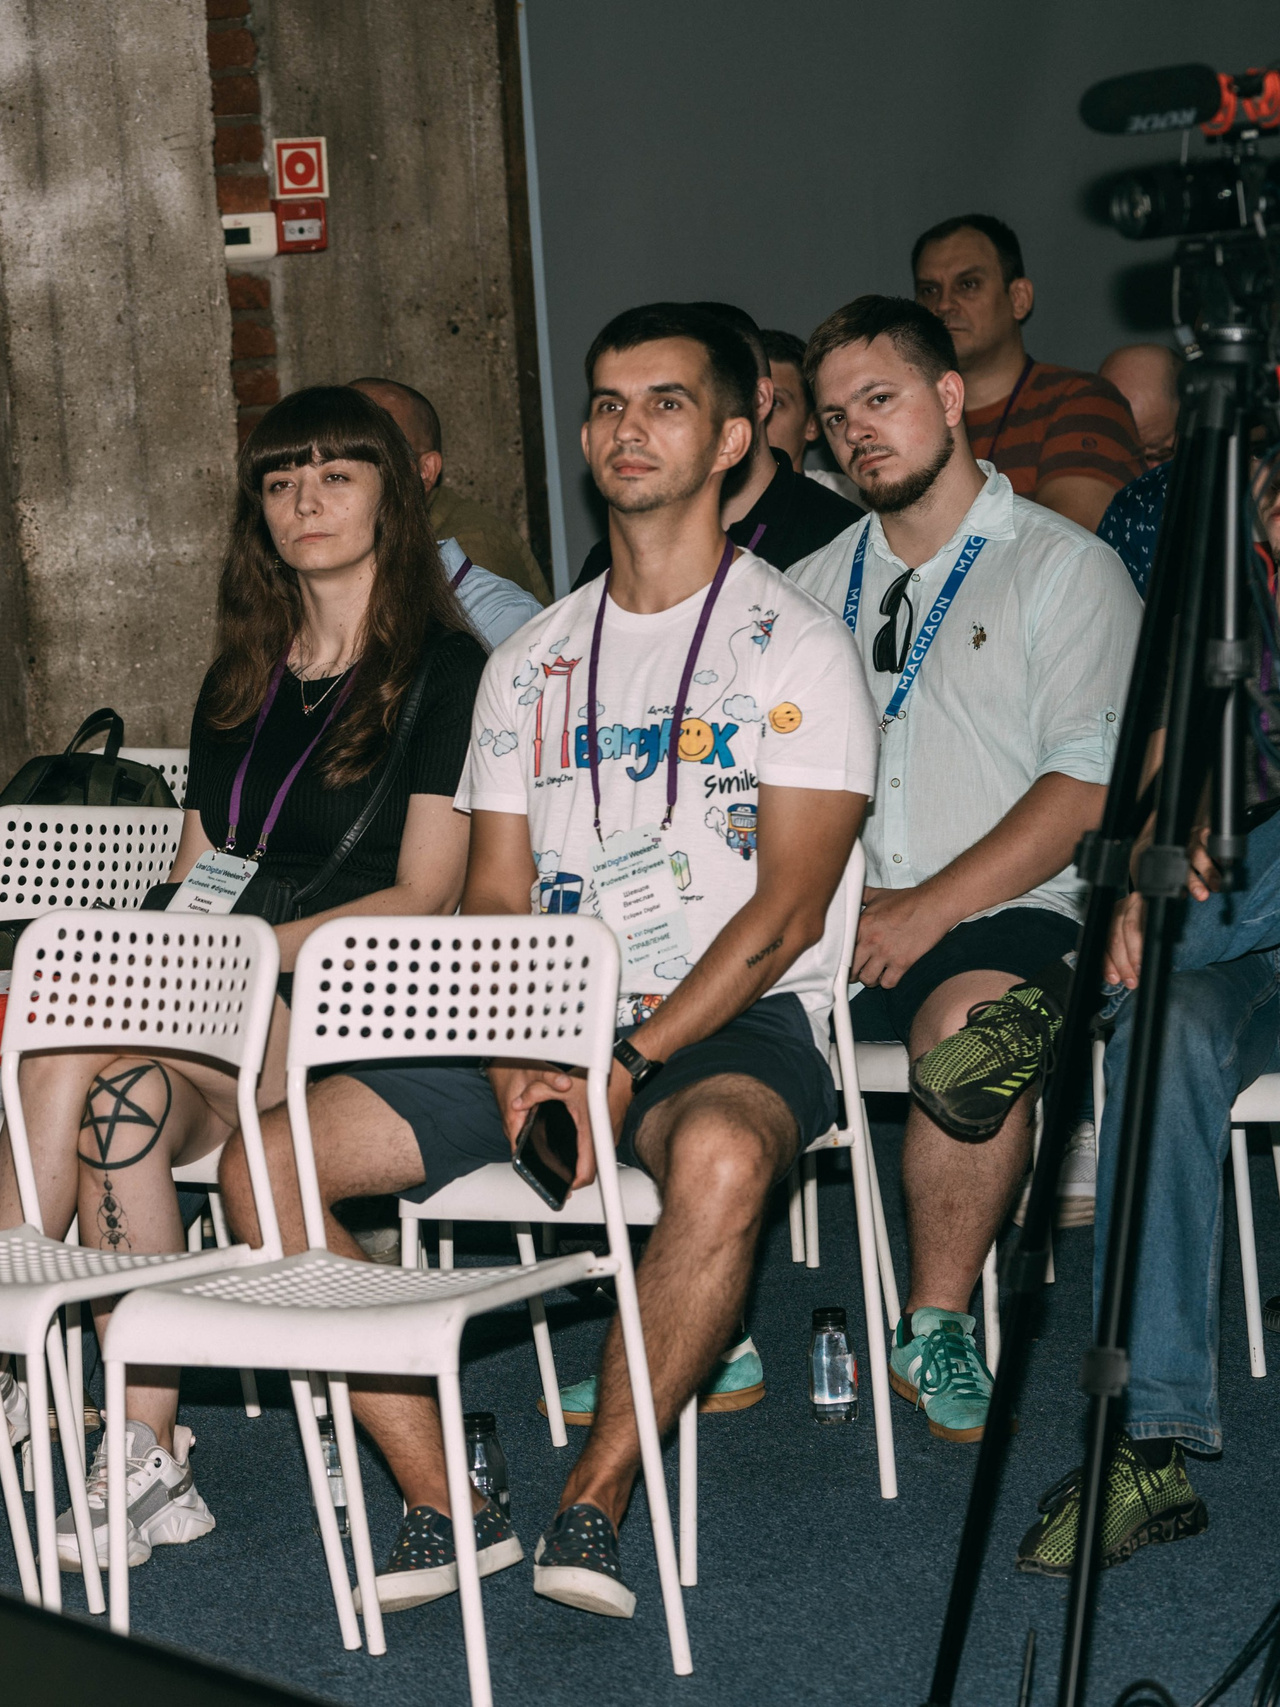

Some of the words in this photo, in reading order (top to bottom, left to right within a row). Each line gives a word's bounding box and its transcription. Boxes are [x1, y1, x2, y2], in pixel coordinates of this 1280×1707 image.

[898, 596, 951, 690] MACHAON
[593, 862, 607, 872] Ural
[607, 854, 629, 867] Digital
[628, 842, 660, 859] Weekend
[206, 865, 224, 875] Digital
[222, 870, 247, 881] Weekend
